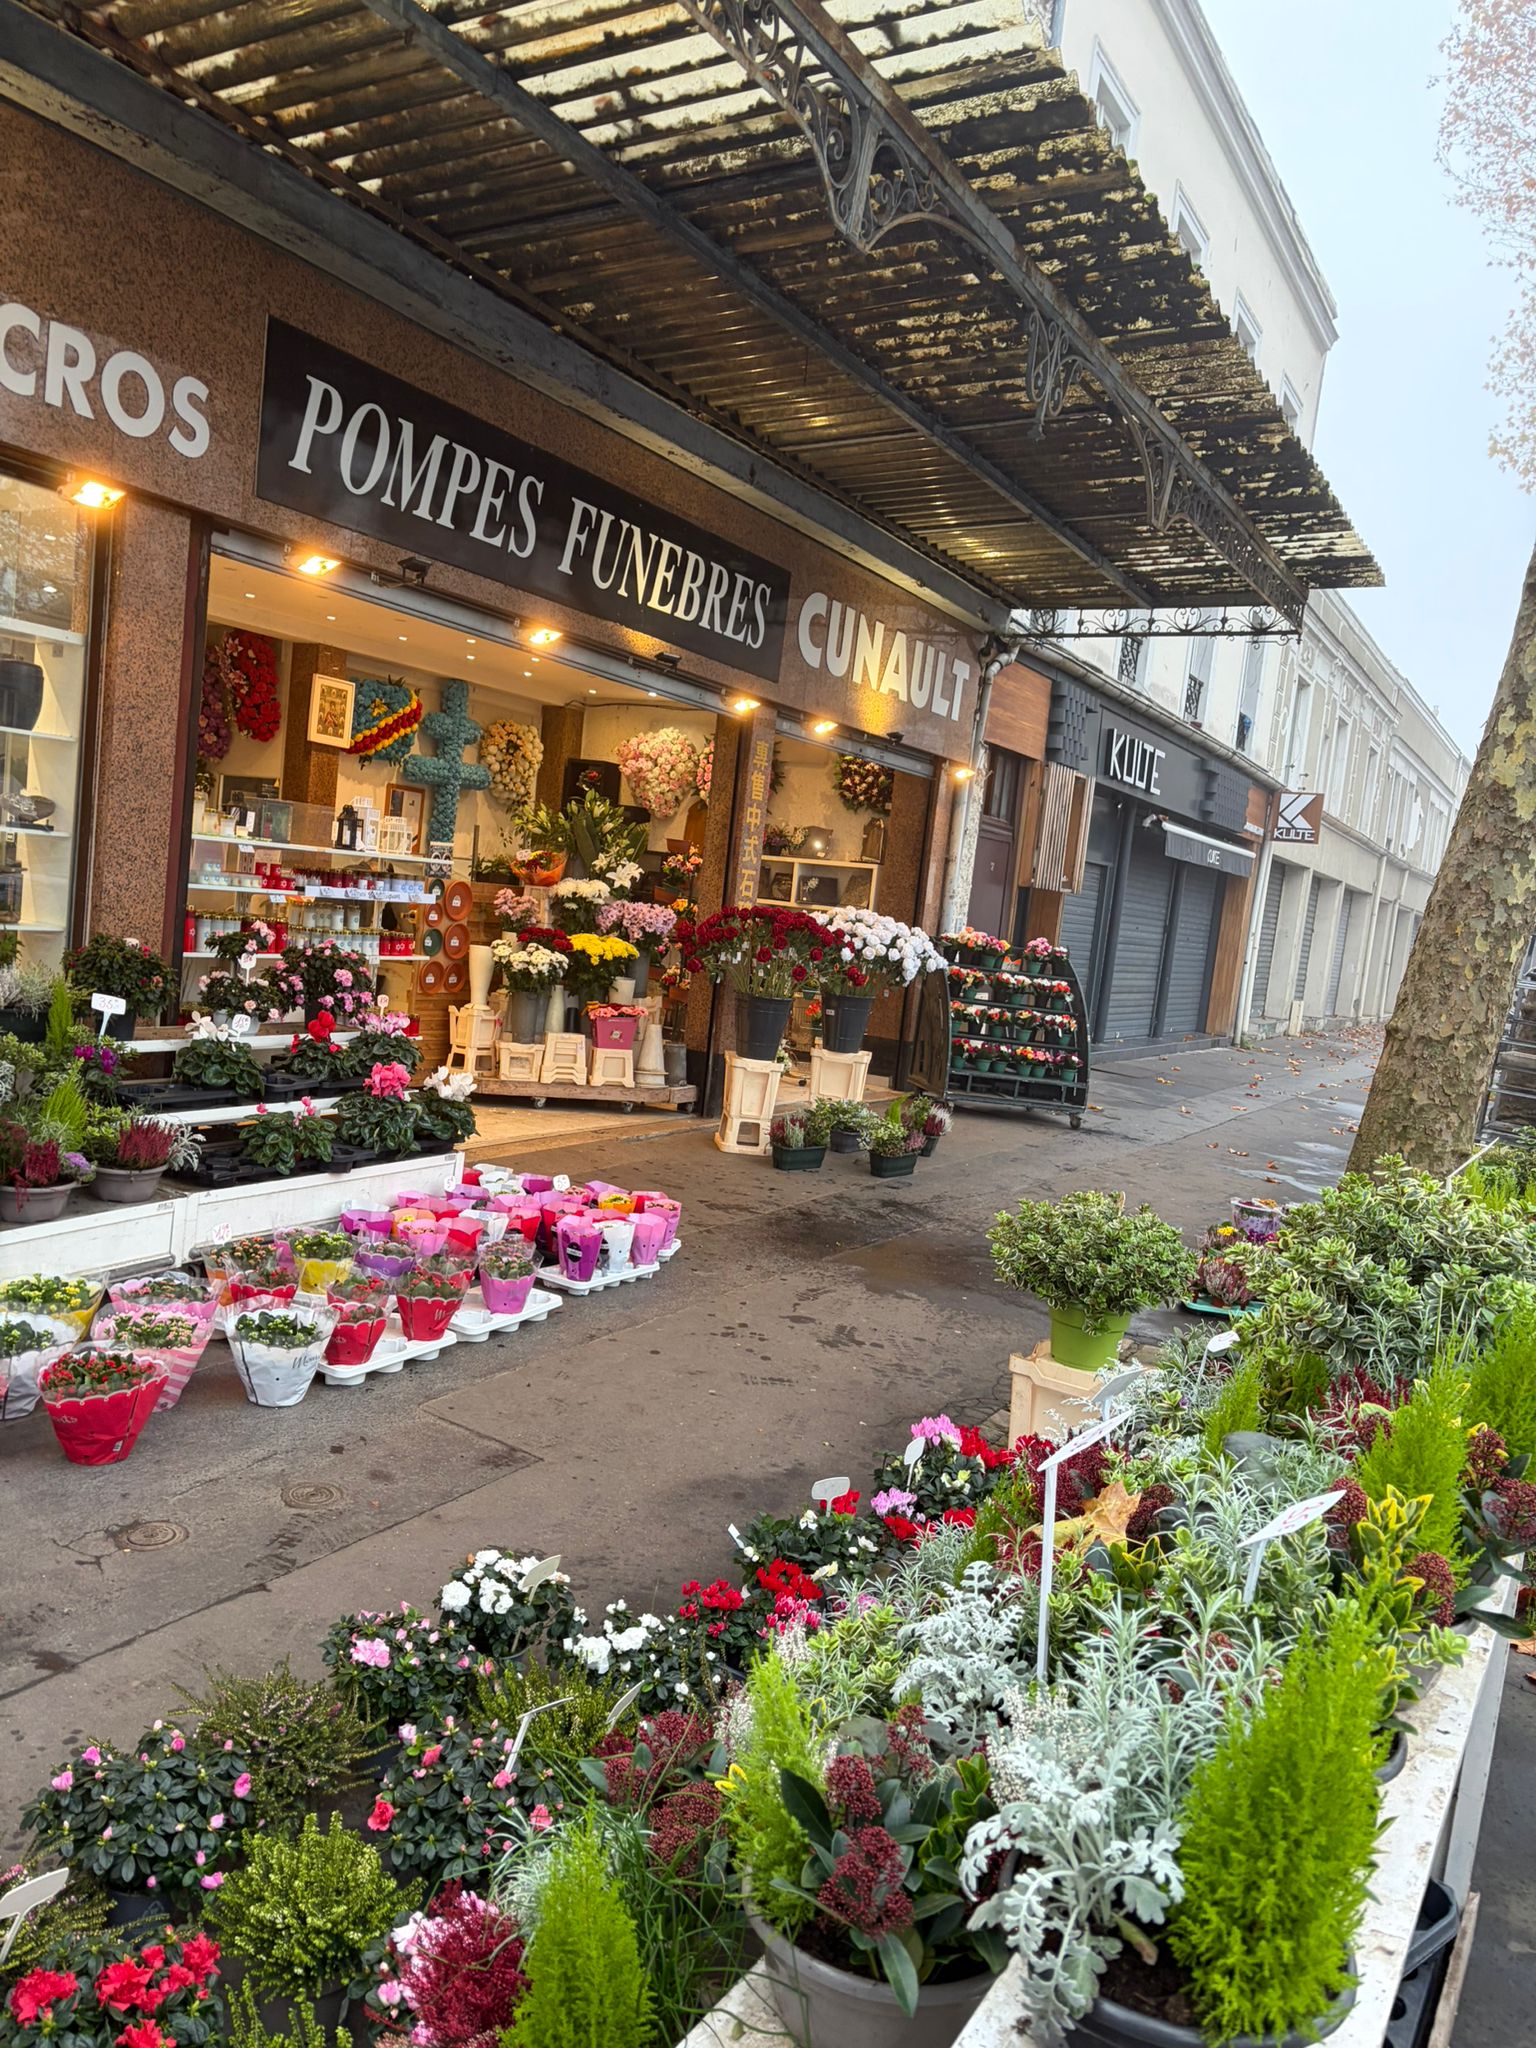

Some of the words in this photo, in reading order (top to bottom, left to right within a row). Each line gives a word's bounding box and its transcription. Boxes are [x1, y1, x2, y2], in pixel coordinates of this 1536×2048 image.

[0, 302, 210, 458] CROS
[288, 374, 543, 558] POMPES
[557, 497, 771, 649] FUNEBRES
[798, 592, 970, 722] CUNAULT
[1108, 728, 1167, 796] KULTE
[1274, 827, 1315, 841] KULTE
